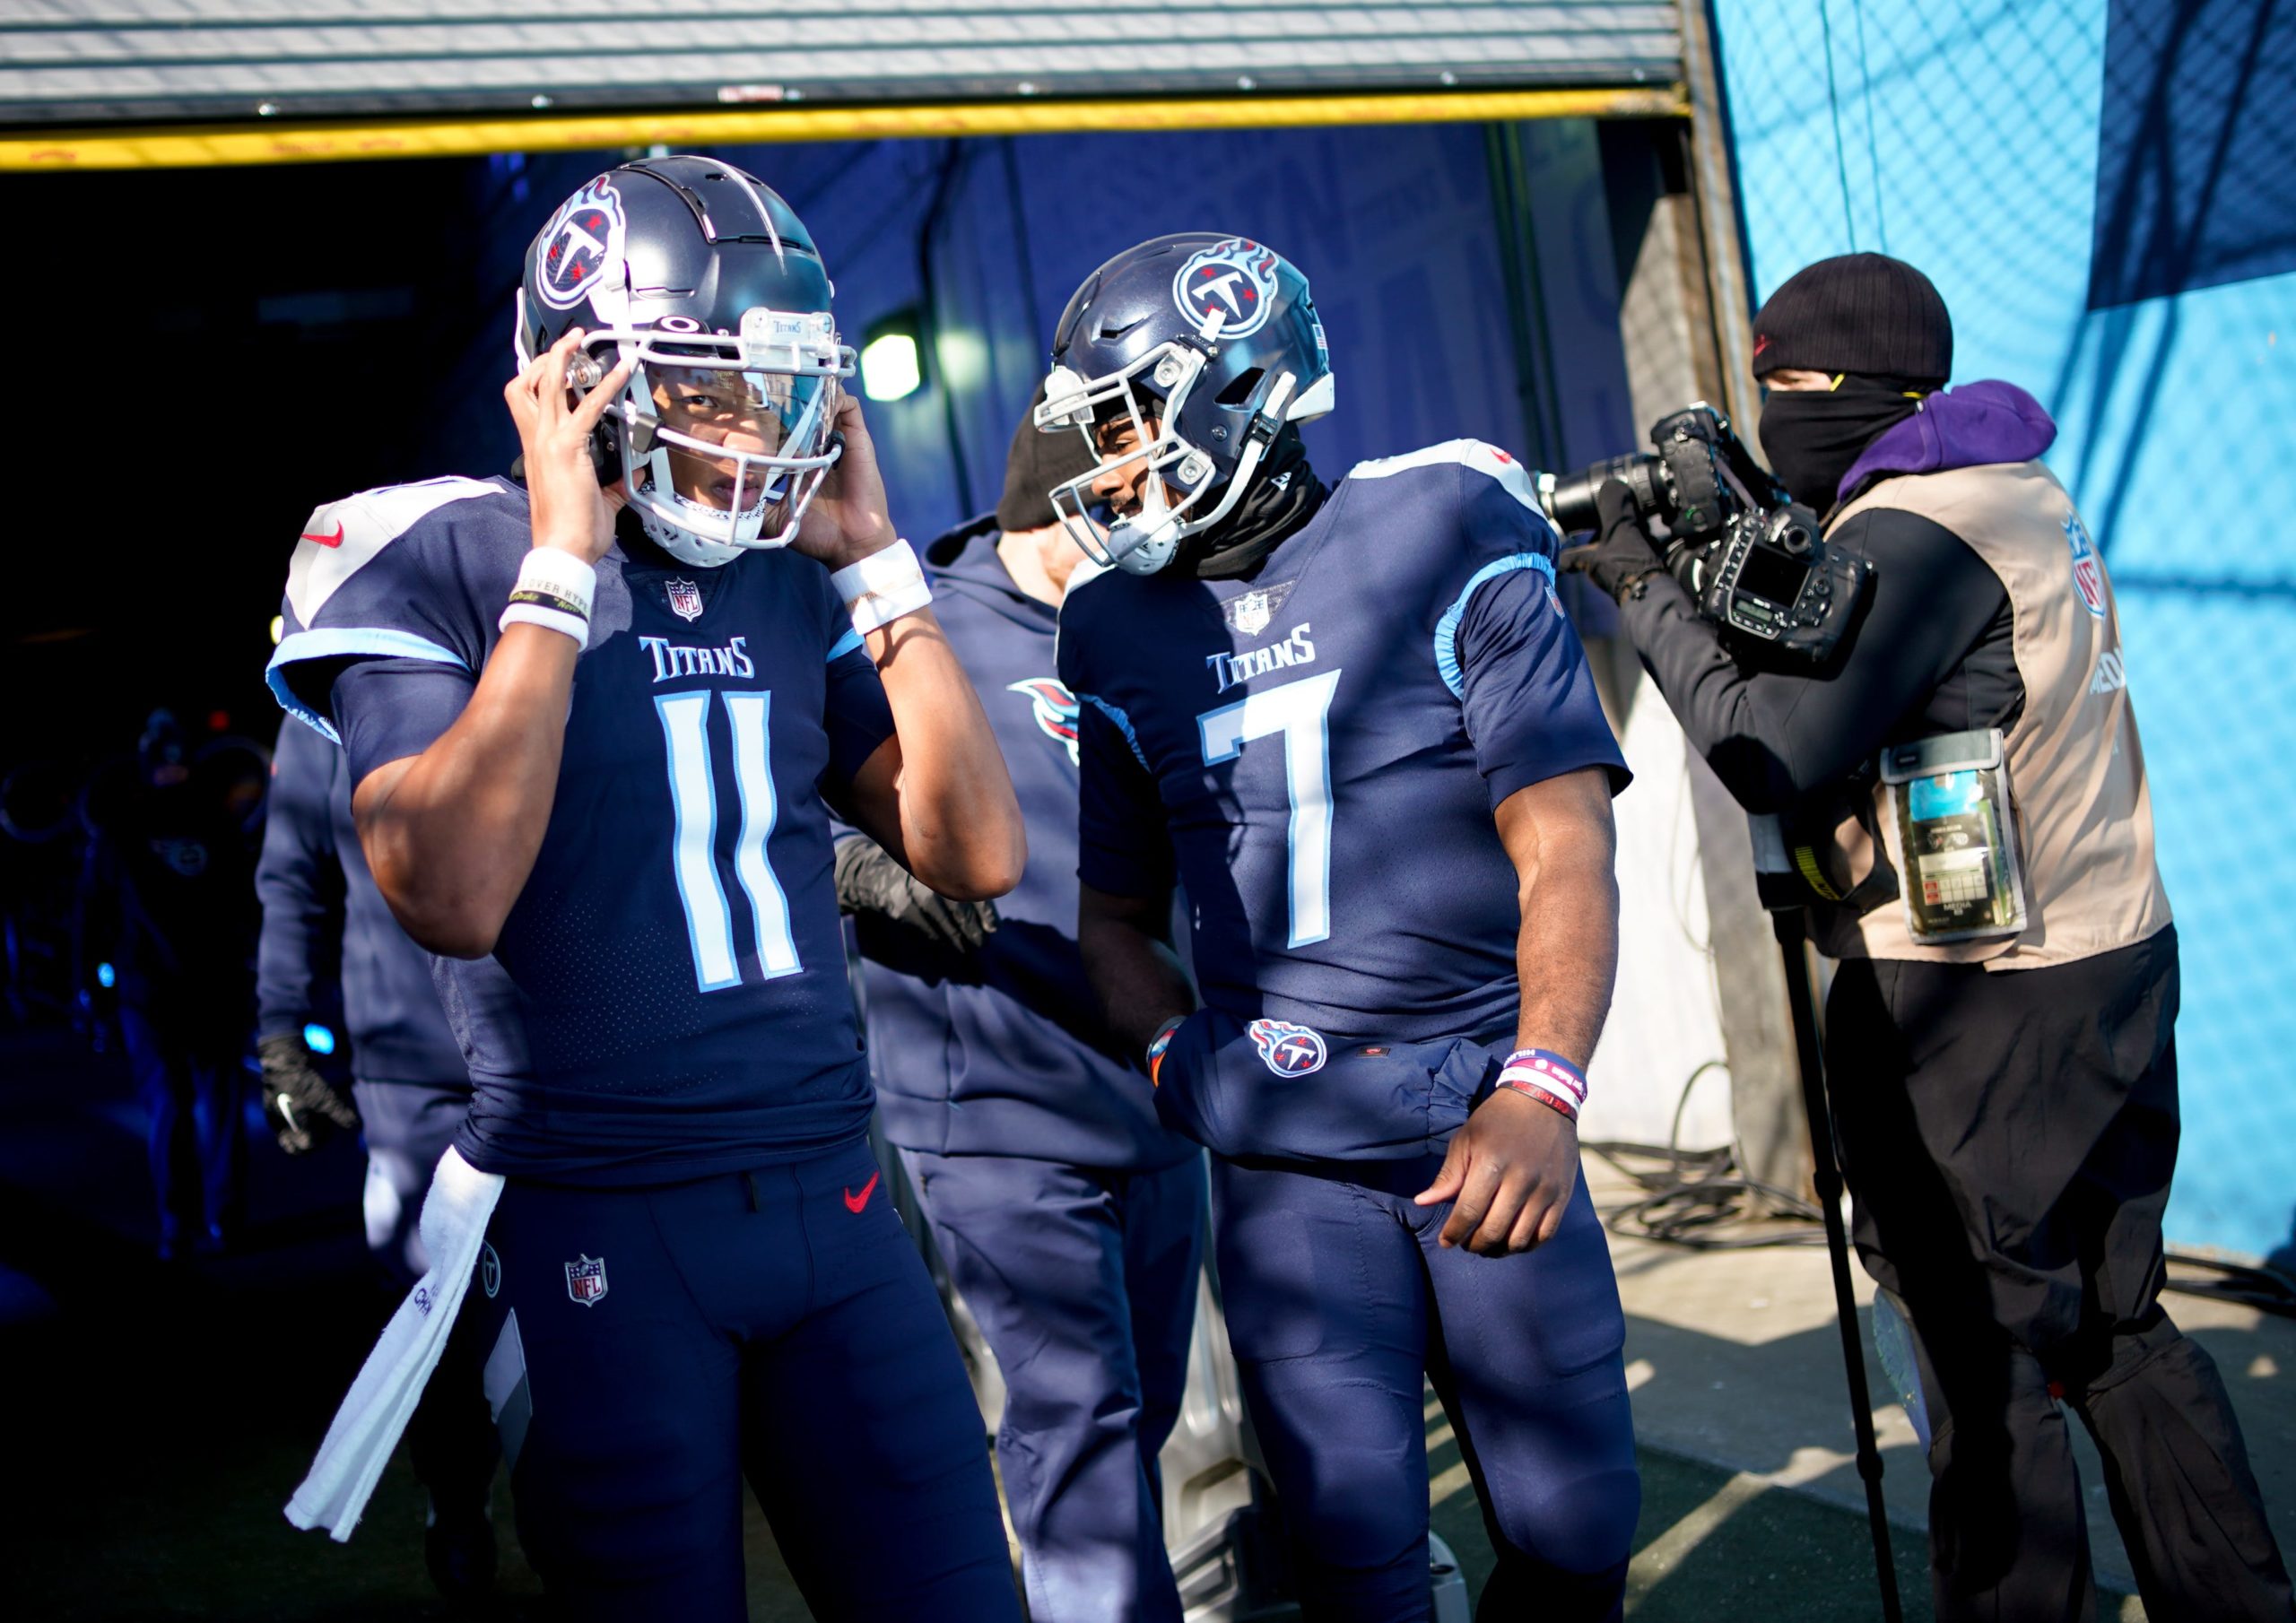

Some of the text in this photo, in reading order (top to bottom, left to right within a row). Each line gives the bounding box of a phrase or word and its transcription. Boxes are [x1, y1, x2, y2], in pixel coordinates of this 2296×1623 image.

[674, 595, 698, 612] NFL
[639, 637, 754, 682] TITANS
[1206, 622, 1316, 694] TITANS
[2090, 647, 2126, 696] MEDI
[1196, 668, 1342, 950] 7
[653, 690, 804, 994] 11
[573, 1277, 601, 1298] NFL
